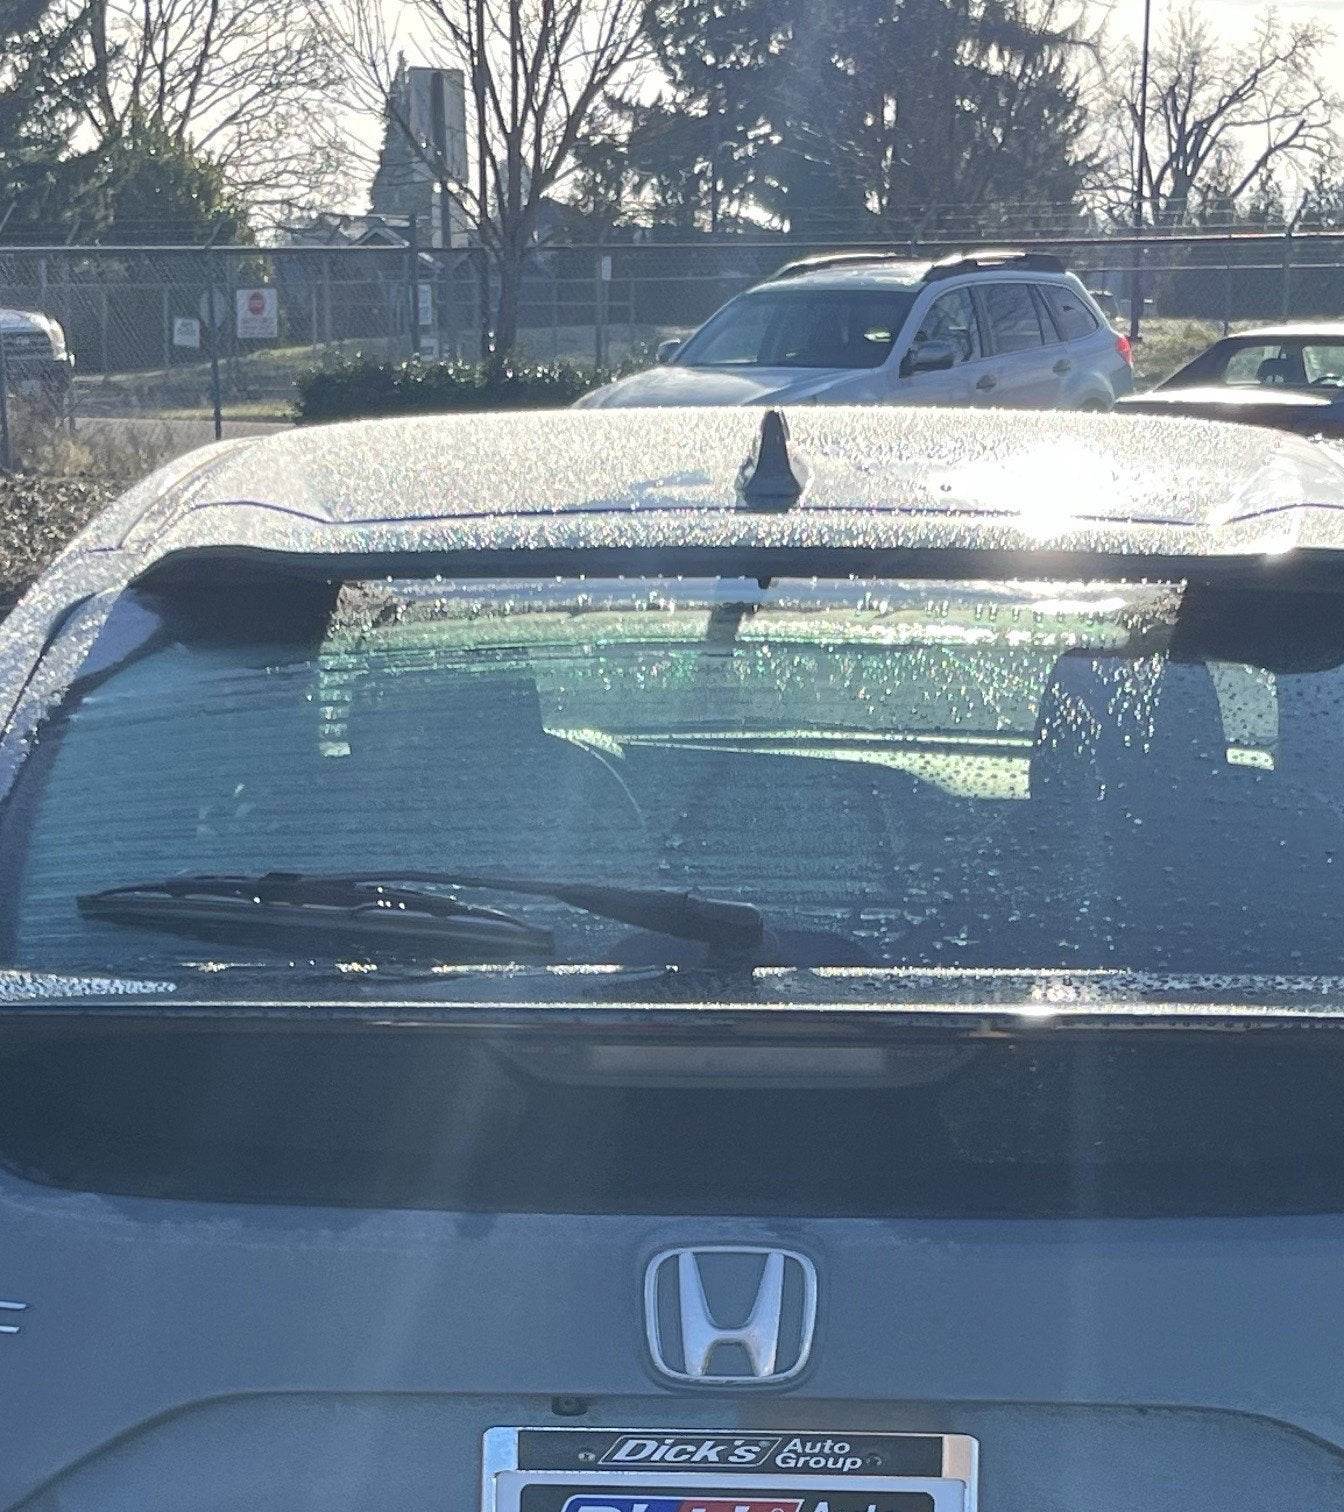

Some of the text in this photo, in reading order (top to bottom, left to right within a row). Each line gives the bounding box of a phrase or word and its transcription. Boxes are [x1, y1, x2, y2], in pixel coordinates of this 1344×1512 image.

[611, 1437, 760, 1464] Dick's
[783, 1438, 851, 1455] Auto
[775, 1452, 863, 1472] Group
